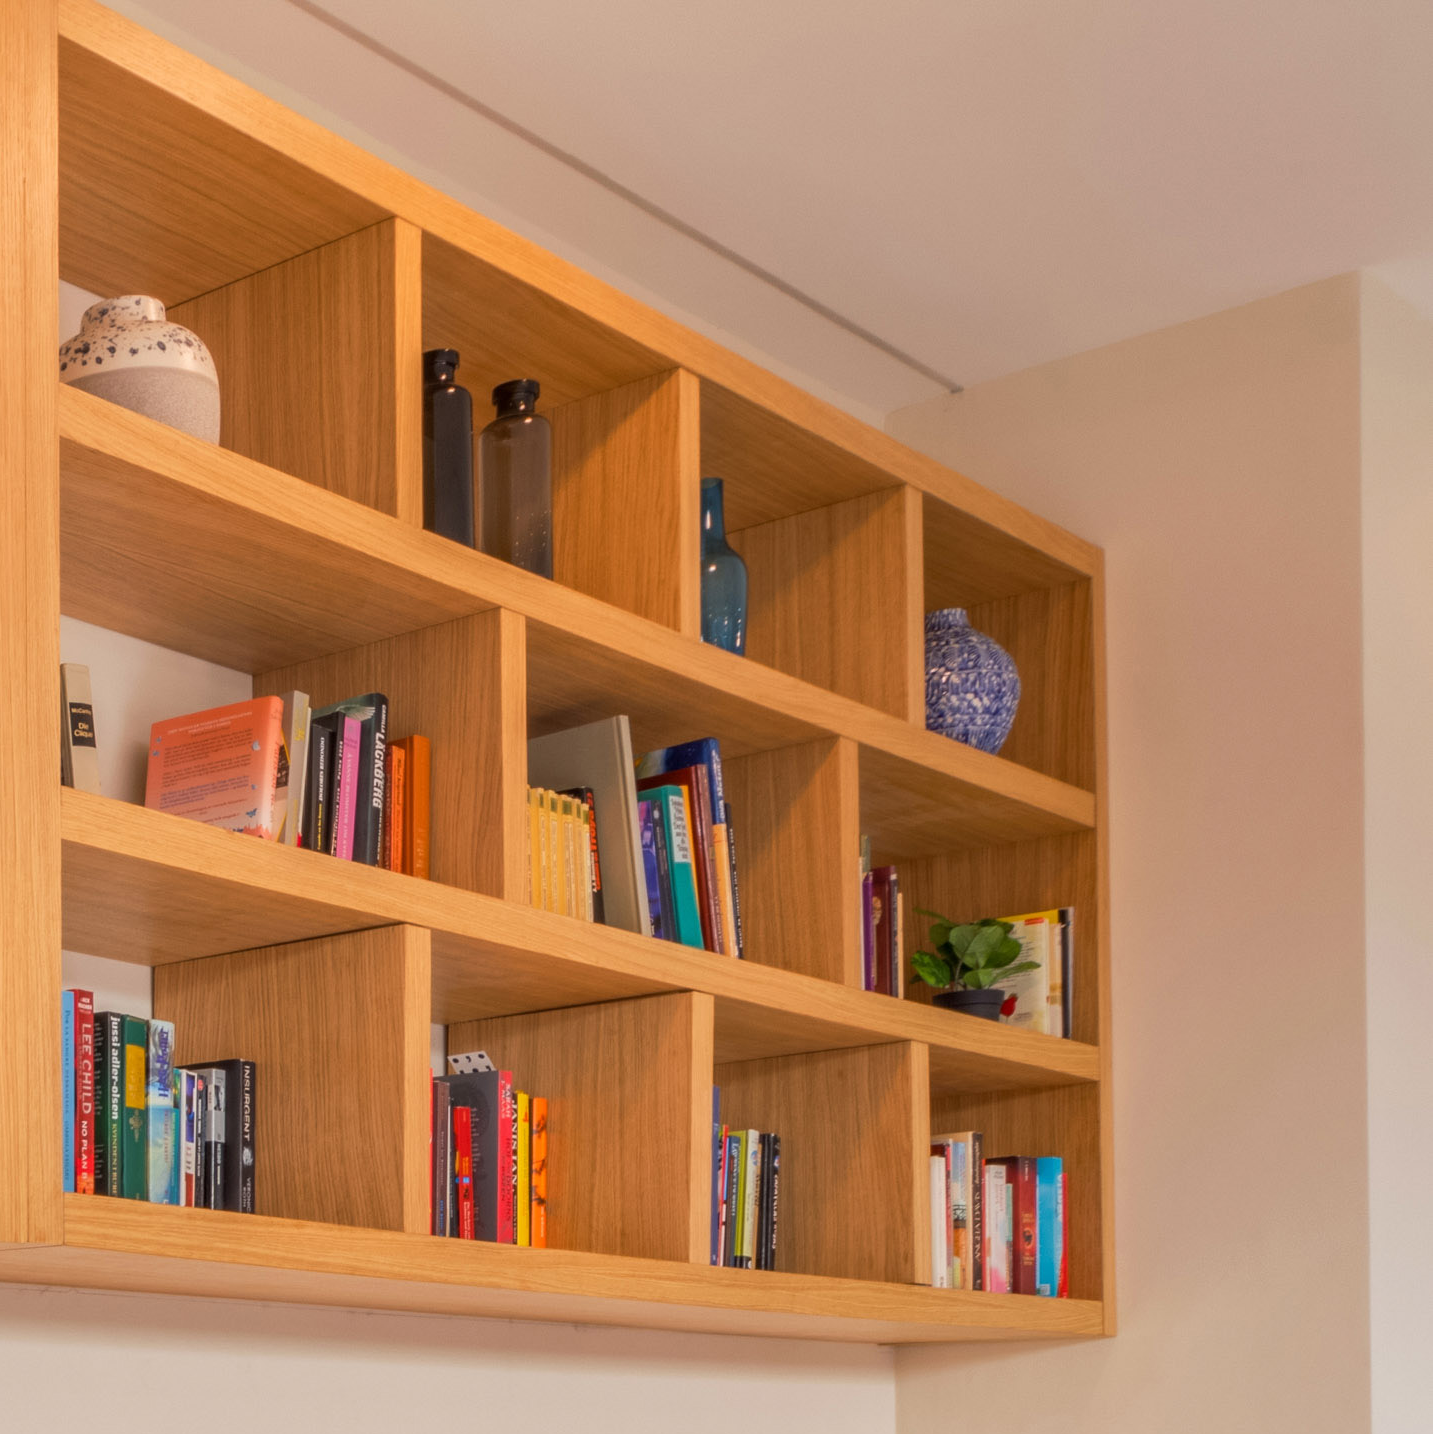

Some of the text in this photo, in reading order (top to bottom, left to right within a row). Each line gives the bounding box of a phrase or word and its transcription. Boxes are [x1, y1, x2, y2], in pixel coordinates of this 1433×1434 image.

[372, 732, 387, 809] LÄCKBERG
[81, 1022, 93, 1115] LEE CHILD
[110, 1016, 121, 1120] jussi adler-olsen
[243, 1065, 251, 1141] INSURGENT
[80, 1120, 88, 1137] NO
